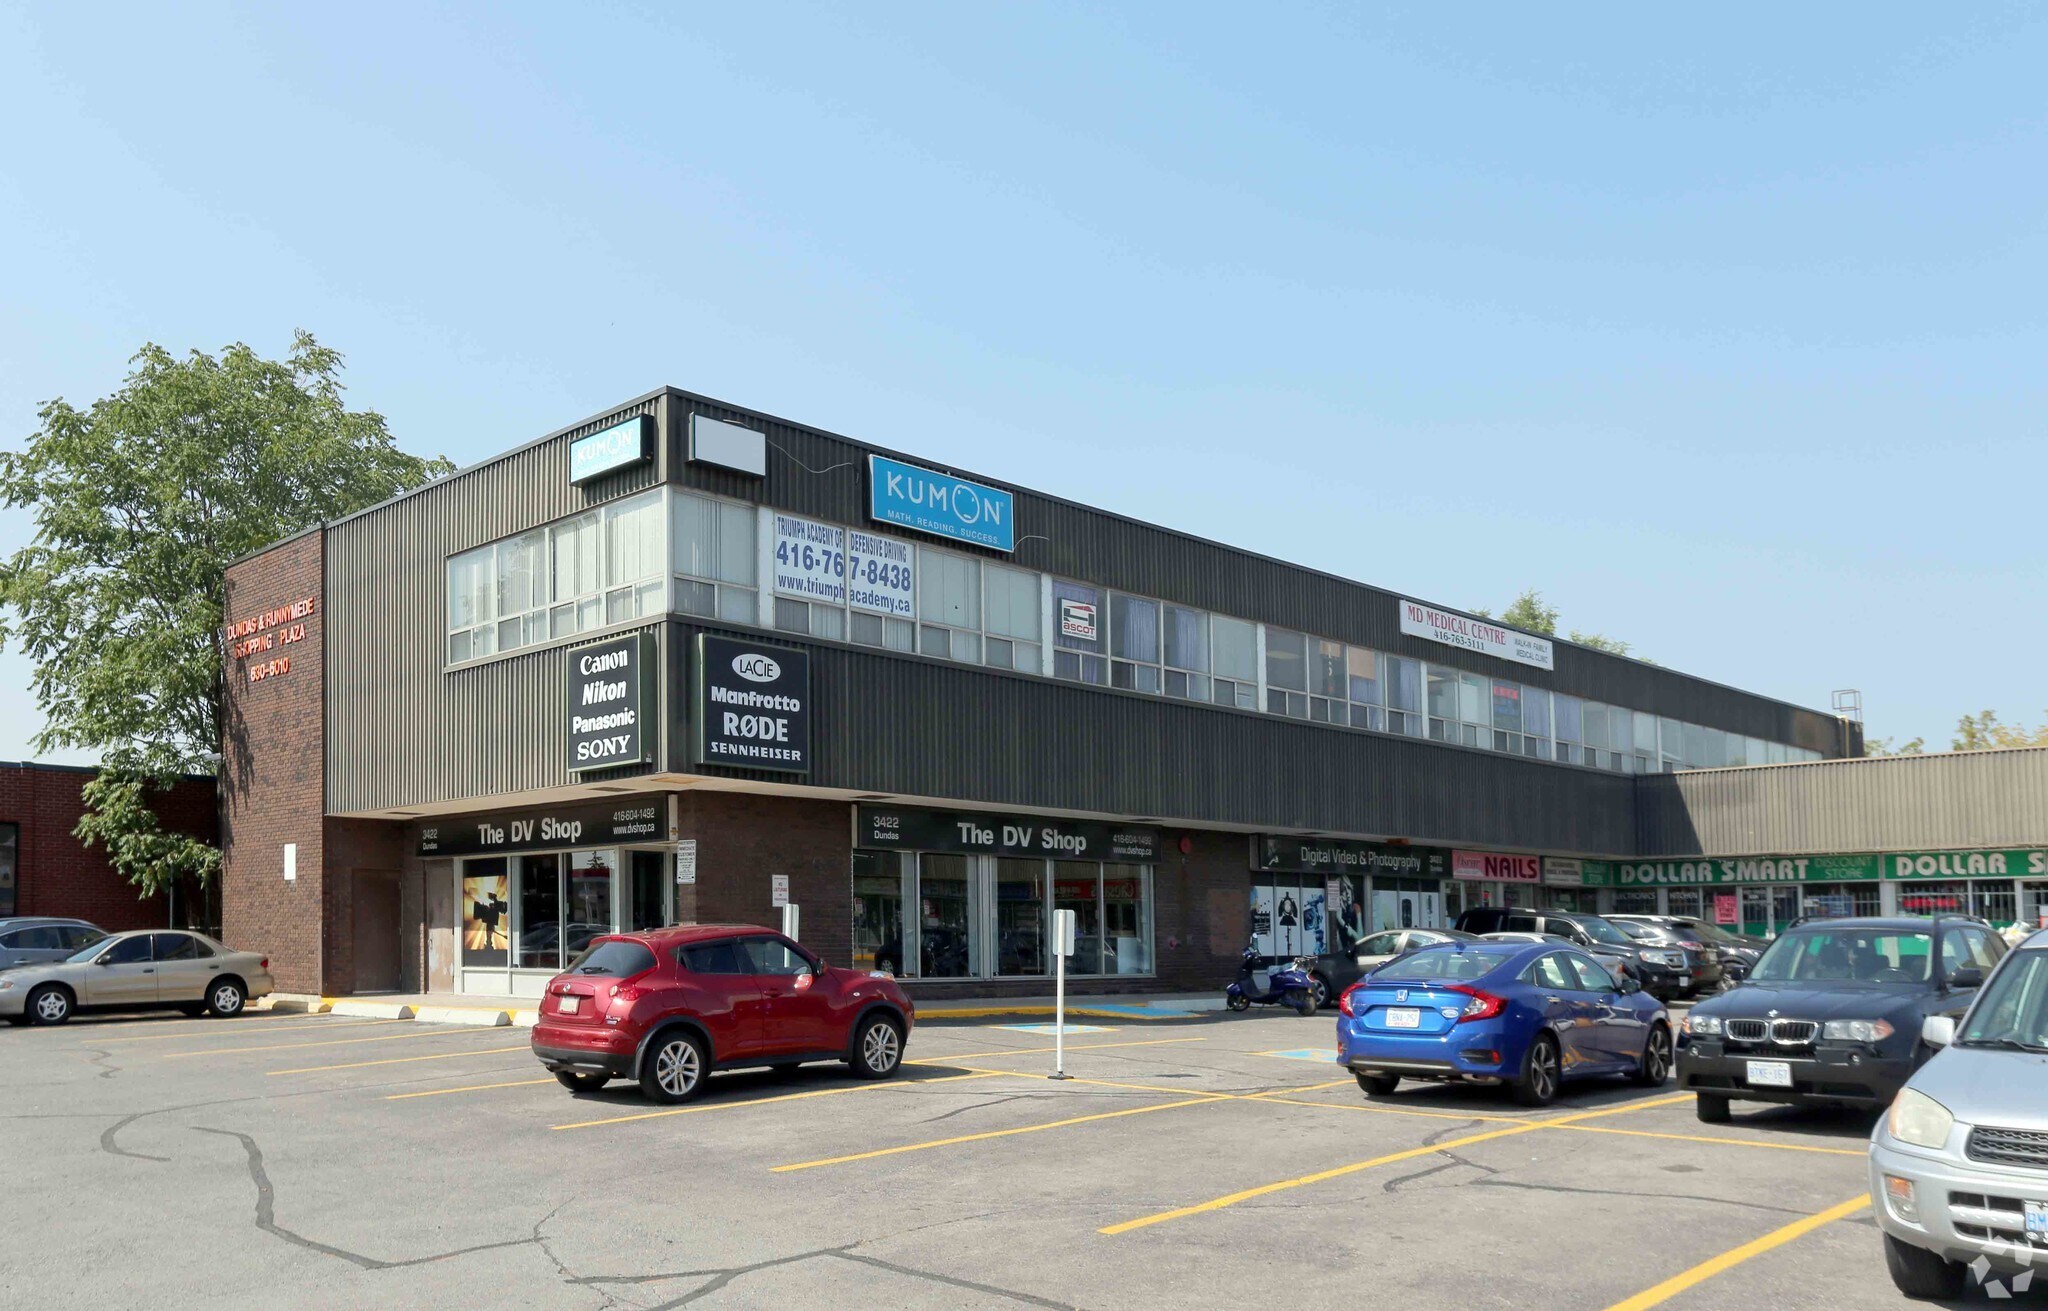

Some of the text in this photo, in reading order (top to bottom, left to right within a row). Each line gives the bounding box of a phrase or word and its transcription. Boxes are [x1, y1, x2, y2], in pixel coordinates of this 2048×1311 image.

[577, 427, 634, 465] KUMON
[887, 470, 1001, 526] KUMON
[887, 509, 914, 523] MATH.
[917, 518, 958, 535] READING.
[777, 516, 907, 563] TRIUMPH ACADEMY OF DEFENSIVE DRIVING
[227, 597, 316, 641] DUNDAS & RUNNYMEDE
[1407, 605, 1507, 646] MD MEDICAL CENTRE
[235, 623, 306, 659] SHOPPING PLAZA
[1433, 629, 1485, 651] 416-763-3111
[580, 649, 628, 676] Canon
[1516, 648, 1534, 660] MEDICAL
[582, 680, 627, 706] Nikon
[711, 686, 800, 712] Manfrotto
[572, 707, 635, 735] Panasonic
[723, 712, 788, 742] RØDE
[577, 735, 631, 761] SONY
[711, 741, 801, 761] SENNHEISER
[613, 808, 655, 821] 416-604-1492
[873, 816, 899, 829] 3422
[422, 828, 438, 840] 3422
[478, 817, 582, 845] The DV Shop
[613, 822, 655, 835] www.dvshop.ca
[874, 830, 899, 841] Dundas
[957, 822, 1087, 855] The DV Shop
[422, 841, 438, 851] Dundas
[1301, 846, 1421, 871] Digital Video & Photography
[1485, 856, 1538, 879] NAILS
[1620, 862, 1713, 883] DOLLAR
[1721, 859, 1809, 882] SMART
[1814, 857, 1872, 868] DISCOUNT
[1825, 868, 1863, 879] STORE
[1896, 852, 2007, 876] DOLLAR
